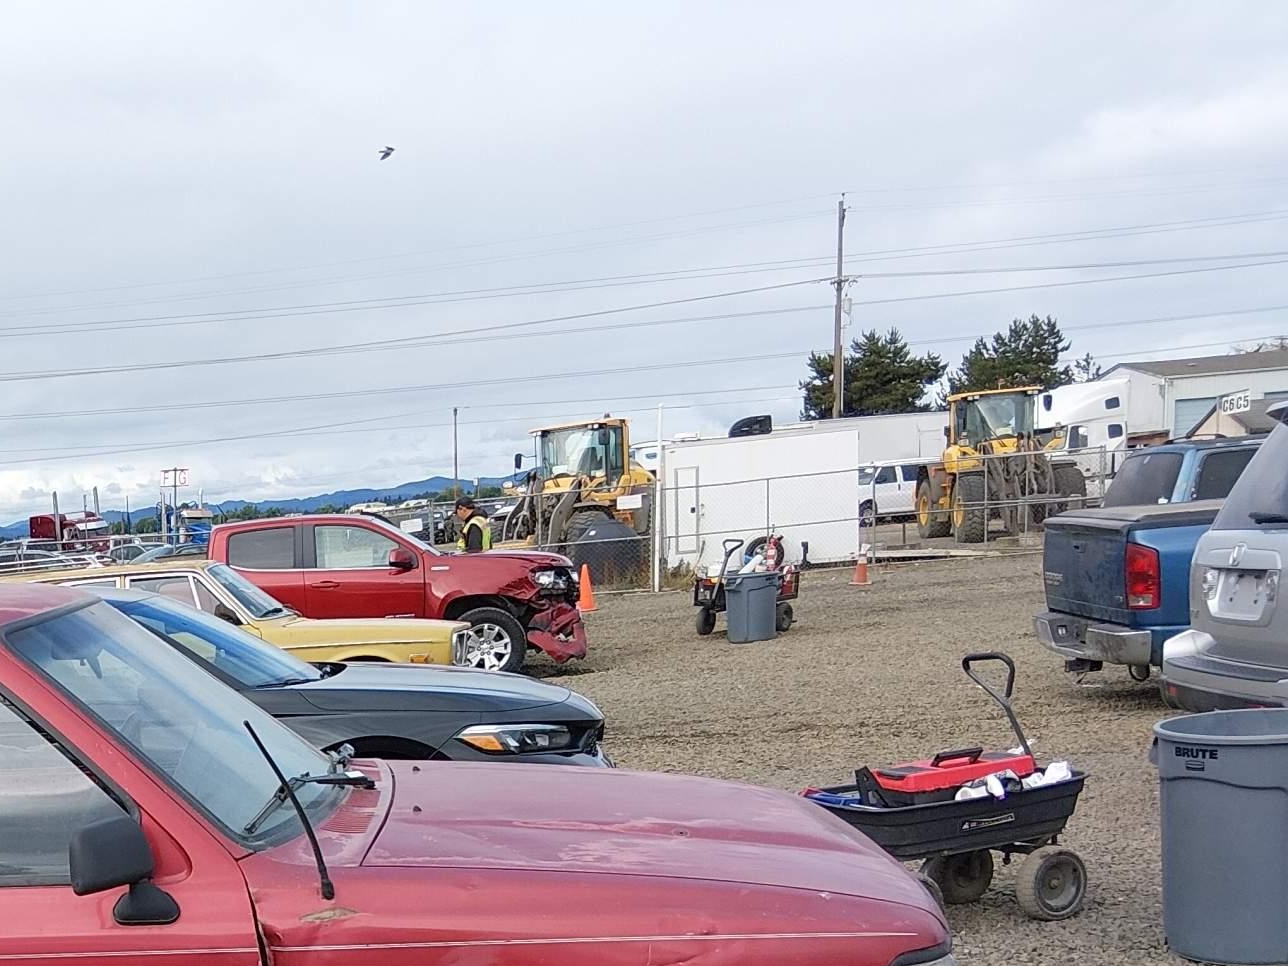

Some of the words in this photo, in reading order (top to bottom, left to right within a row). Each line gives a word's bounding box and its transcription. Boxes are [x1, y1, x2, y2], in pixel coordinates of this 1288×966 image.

[1223, 398, 1235, 412] C6
[1236, 395, 1249, 409] C5
[1175, 746, 1218, 760] BRUTE
